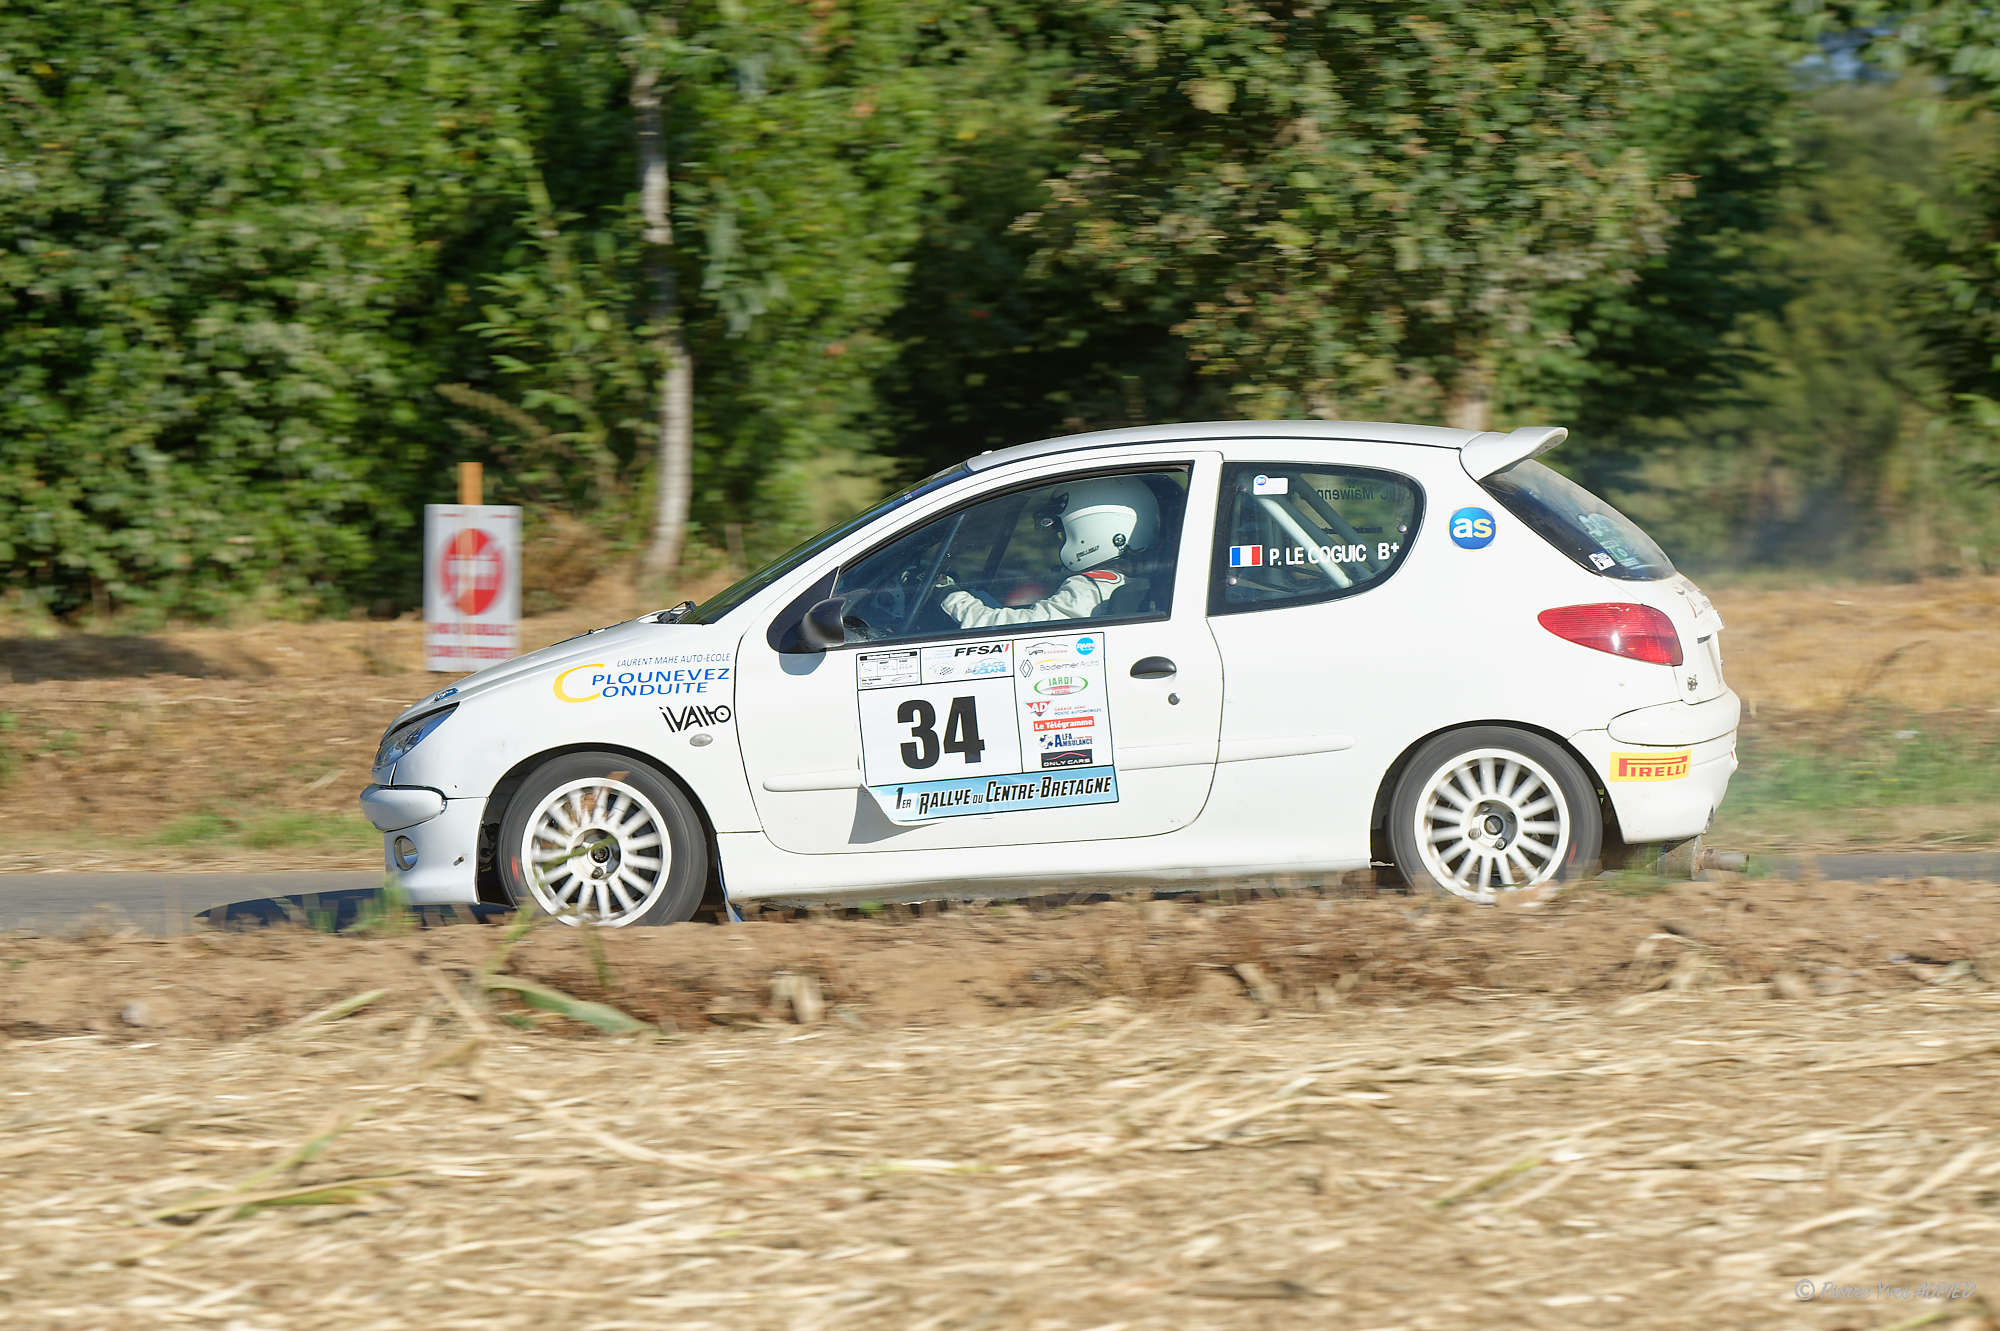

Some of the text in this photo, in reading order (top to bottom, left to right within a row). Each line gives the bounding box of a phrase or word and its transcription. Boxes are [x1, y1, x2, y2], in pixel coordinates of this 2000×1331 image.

[1452, 518, 1493, 538] as
[1269, 548, 1282, 566] P.
[1286, 547, 1305, 565] LE
[1307, 544, 1367, 564] COGUIC
[617, 653, 731, 667] LAURENT MAHE AUTO-ECOLE
[954, 644, 1004, 657] FFSA
[592, 668, 730, 686] PLOUNEVEZ
[1031, 702, 1048, 713] AD
[897, 695, 985, 770] 34
[1035, 719, 1093, 730] Le Télégramme
[1618, 756, 1688, 777] PIRELLI
[918, 789, 971, 815] RALLYE
[972, 794, 984, 804] DU
[985, 776, 1112, 803] CENTRE-BRETAGNE
